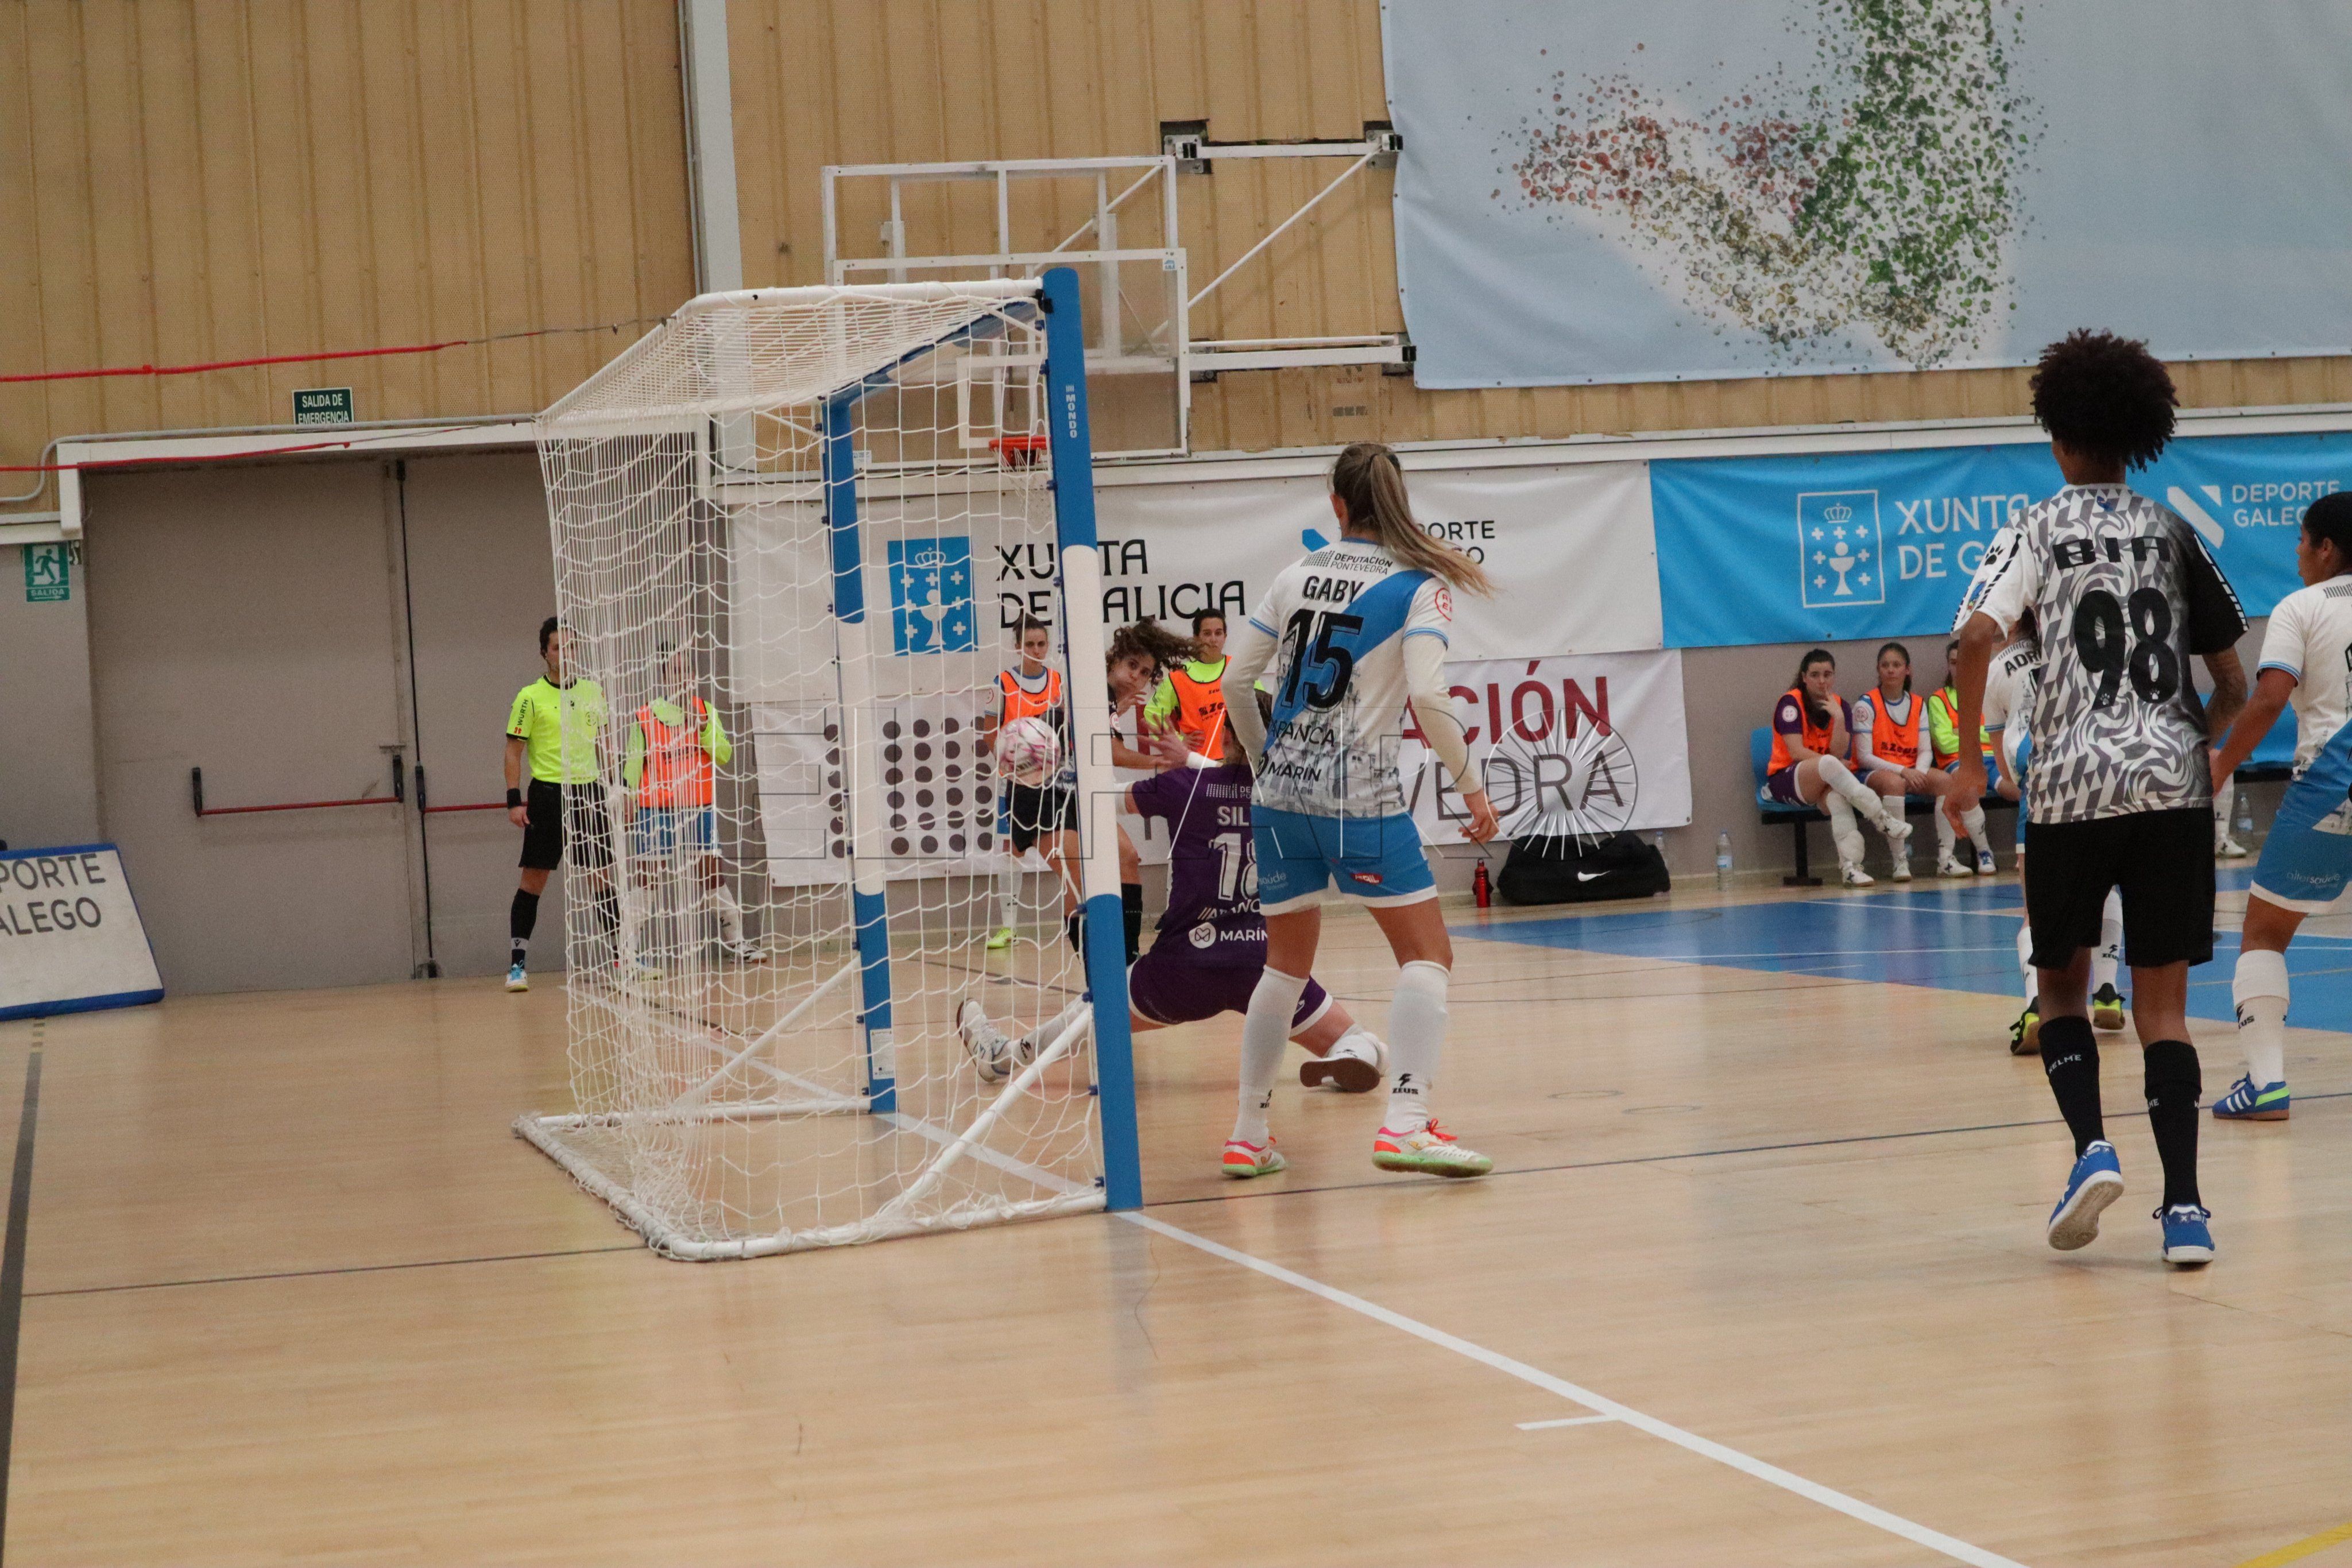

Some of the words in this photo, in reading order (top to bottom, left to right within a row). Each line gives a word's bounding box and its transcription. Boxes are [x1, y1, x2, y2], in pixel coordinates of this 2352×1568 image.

[298, 411, 350, 424] EMERGENCIA
[302, 394, 331, 408] SALIDA
[332, 393, 343, 406] DE
[1066, 394, 1077, 438] MONDO
[2232, 481, 2340, 503] DEPORTE
[1895, 494, 2028, 535] XUNTA
[995, 539, 1148, 581] XUTA
[1330, 562, 1388, 575] PONTEVEDRA
[1334, 553, 1393, 568] DEPUTACIÓN
[1898, 543, 1947, 580] DE
[2053, 535, 2171, 570] BIA
[997, 590, 1053, 629] DE
[1102, 580, 1246, 623] ALICIA
[1302, 576, 1365, 604] GABY
[1281, 609, 1364, 714] 15
[2074, 587, 2180, 710] 98
[517, 699, 529, 726] WÜRTH
